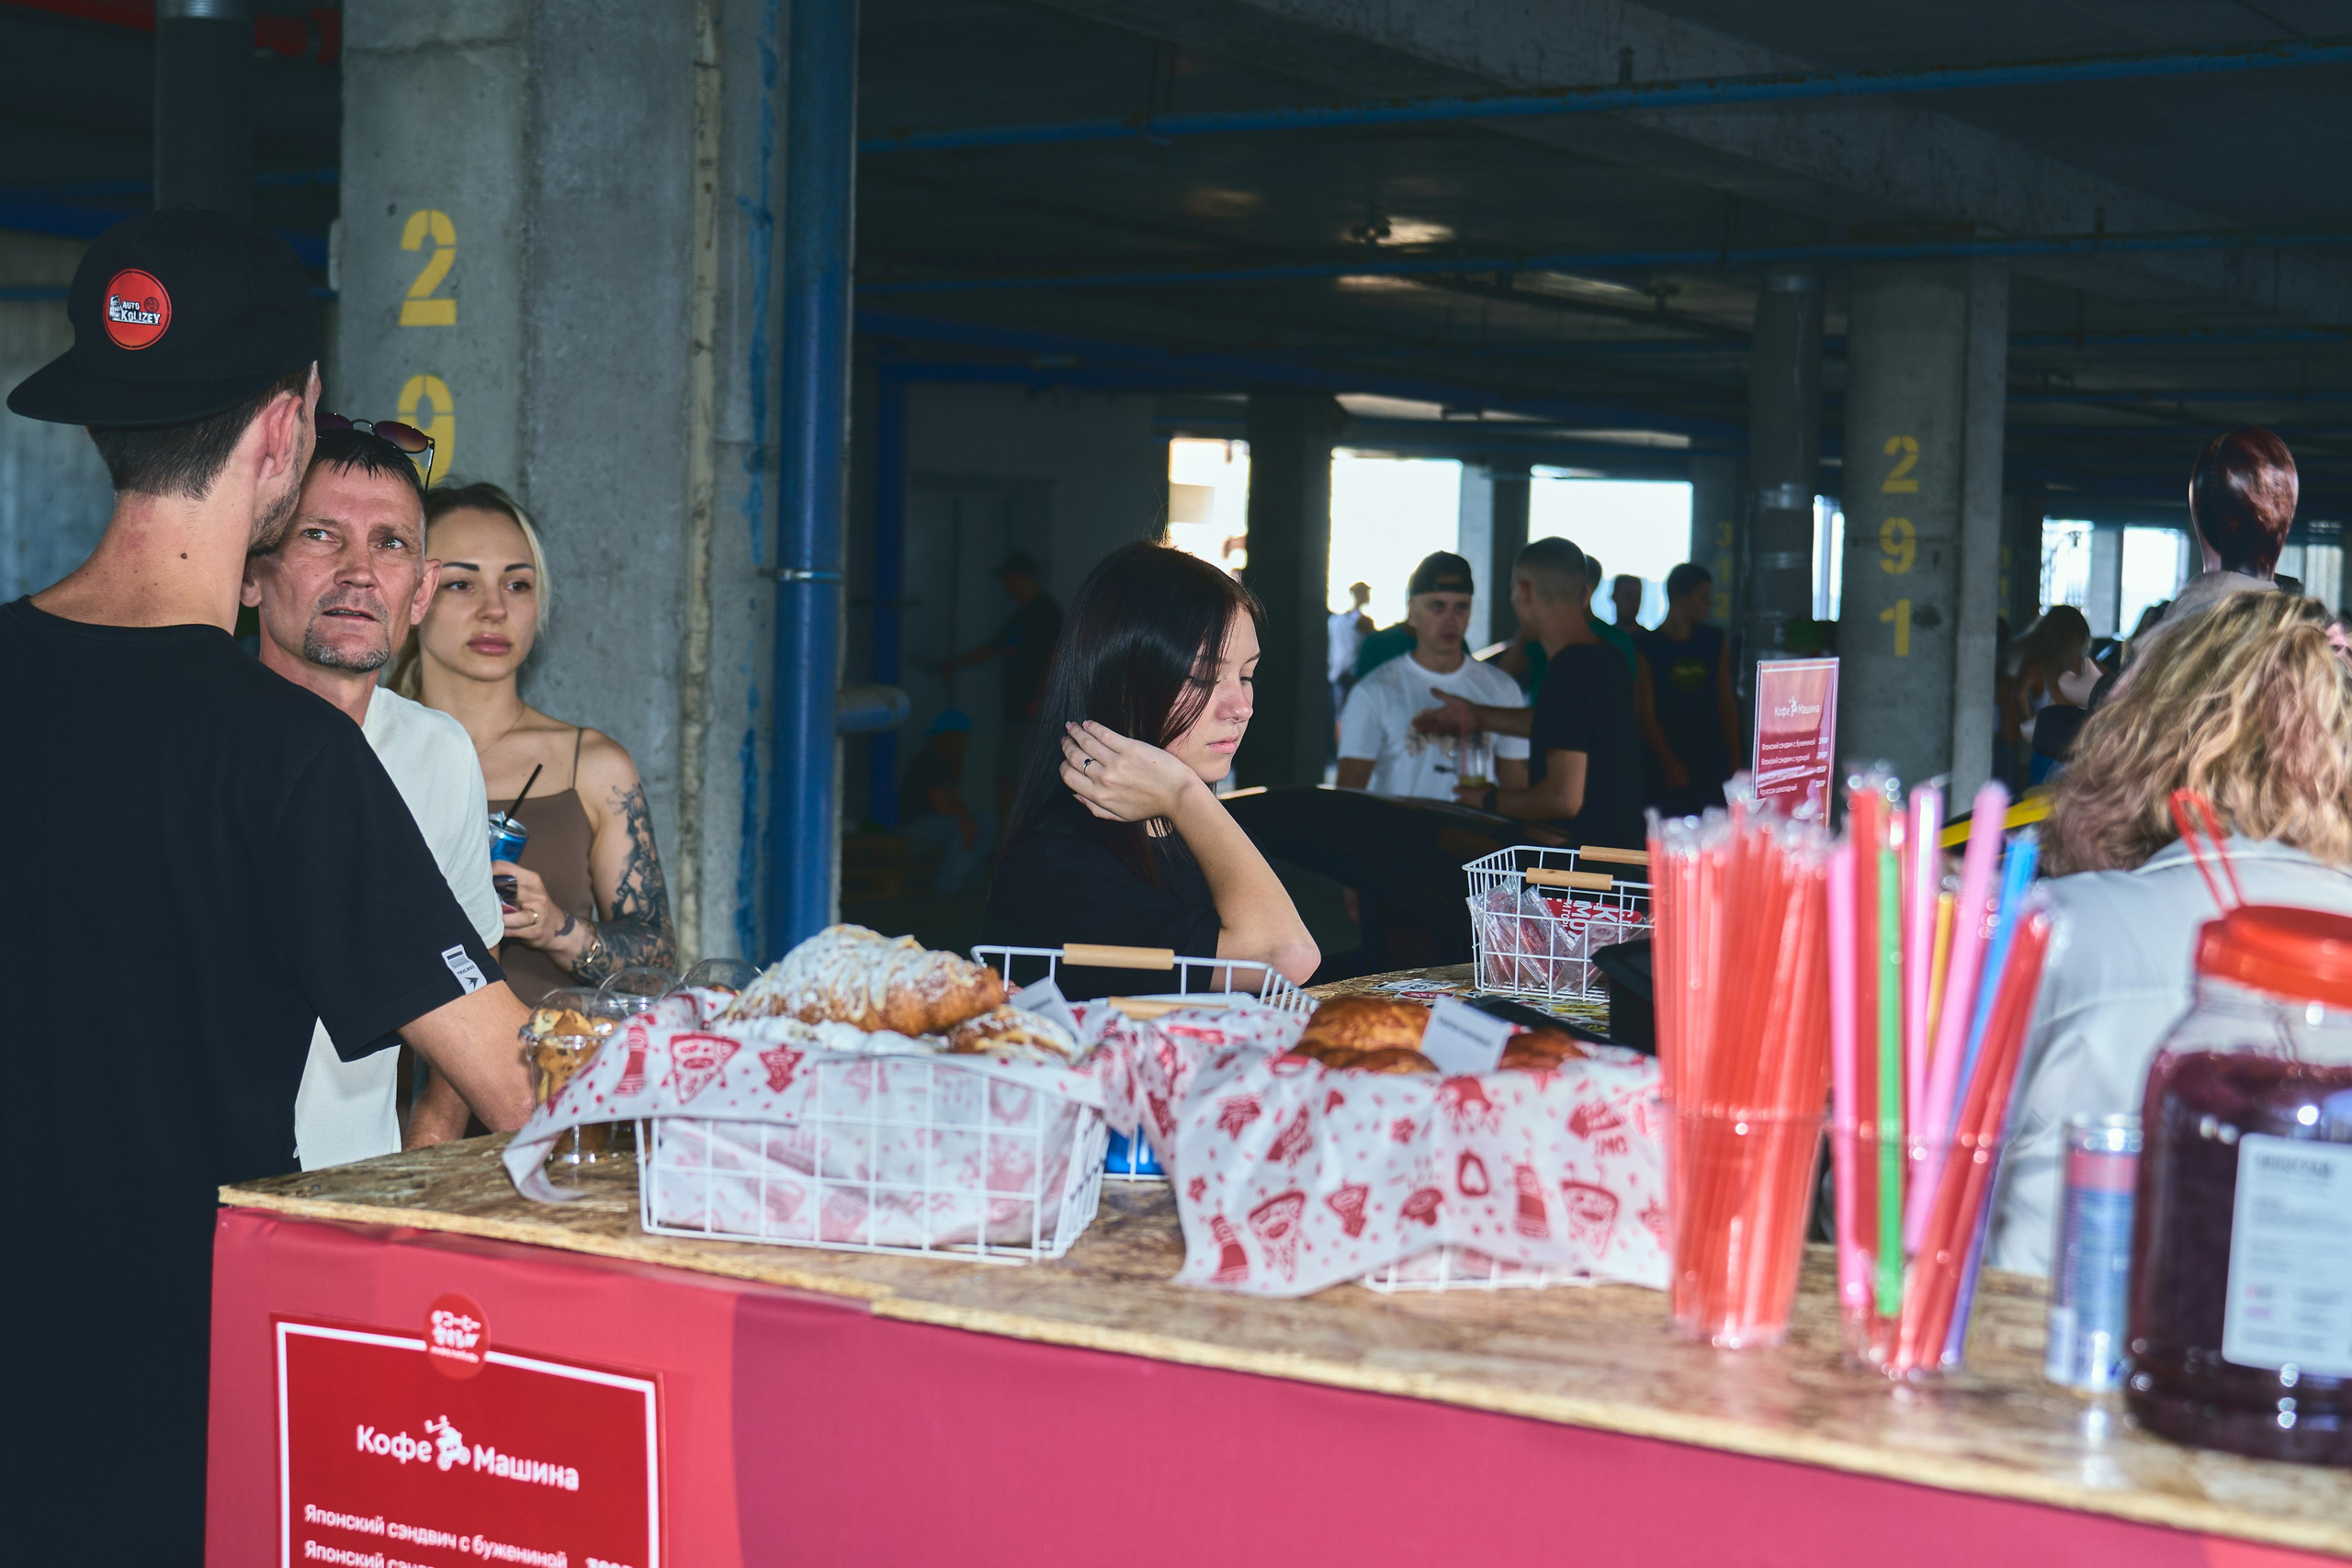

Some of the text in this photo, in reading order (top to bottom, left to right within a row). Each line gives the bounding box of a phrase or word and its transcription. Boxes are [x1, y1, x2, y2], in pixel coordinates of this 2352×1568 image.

[122, 300, 141, 310] AUTO
[120, 310, 161, 324] KOLIZEY
[1774, 704, 1820, 718] Кофе Машина
[356, 1424, 580, 1492] Кофе Машина
[304, 1504, 568, 1568] Японский сэндвич с бужениной
[304, 1540, 385, 1568] Японский
